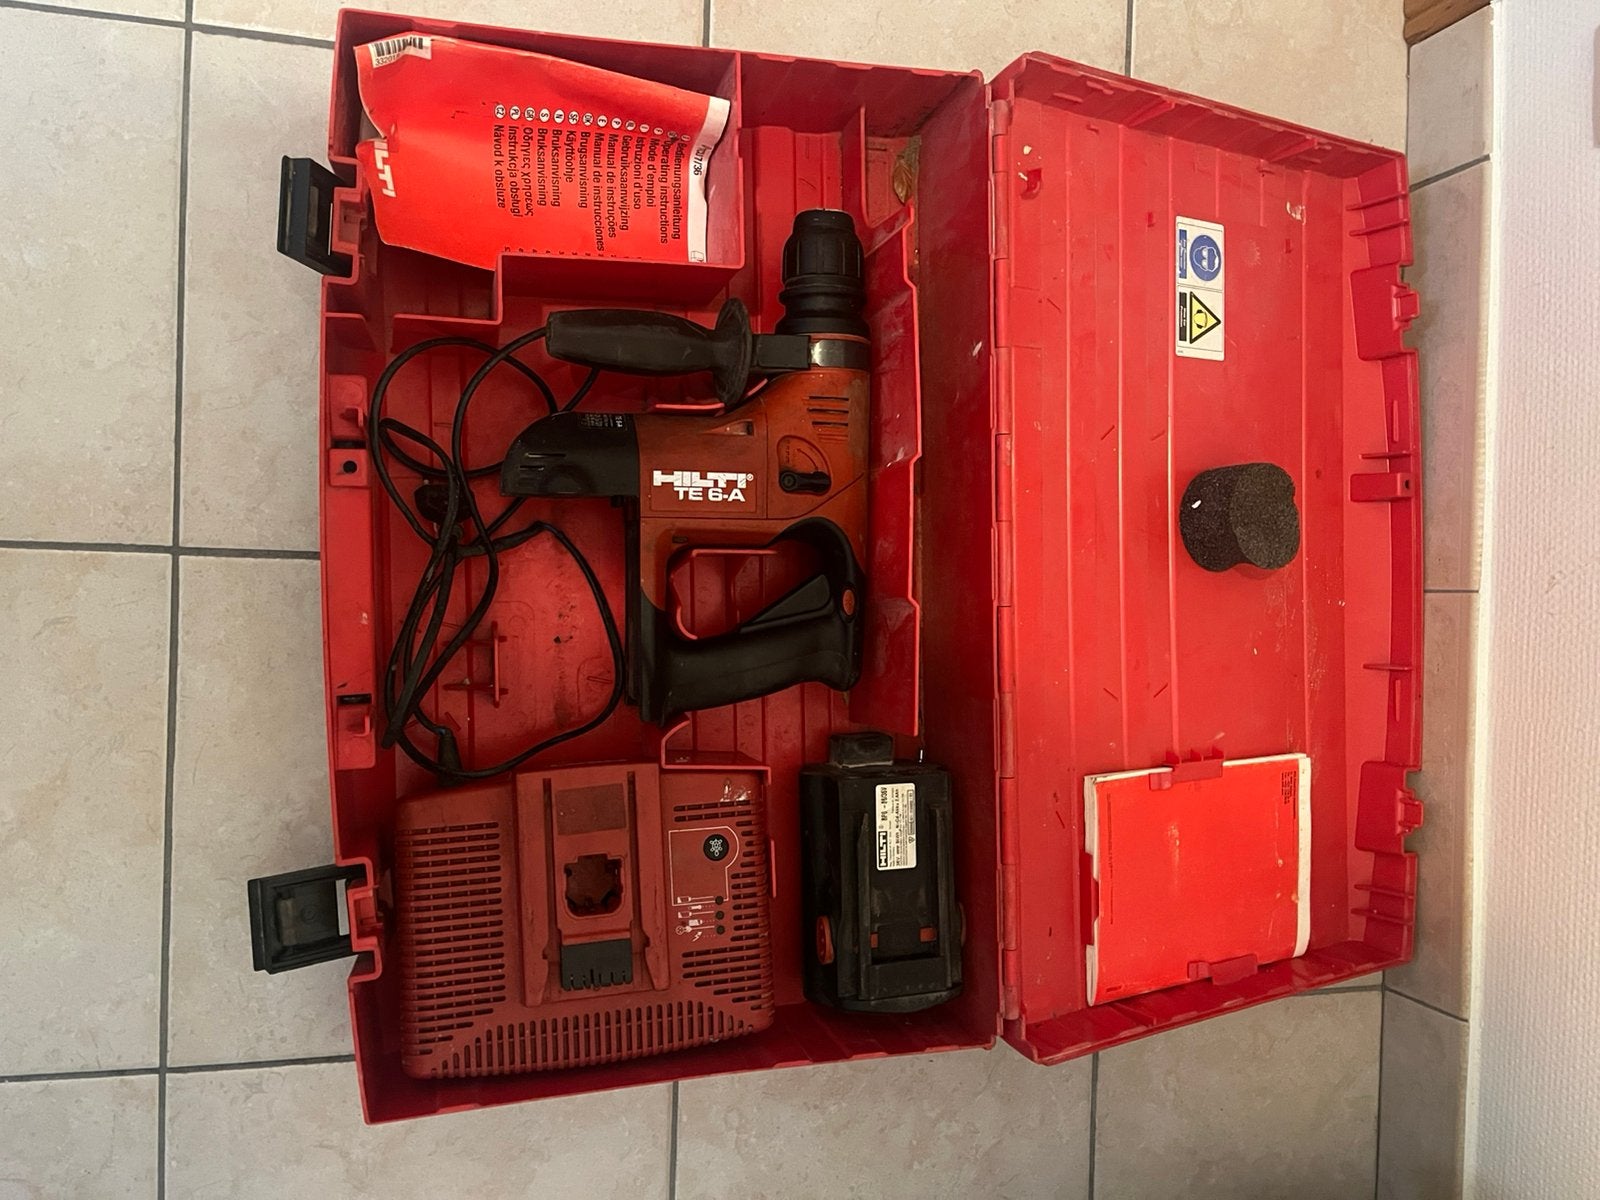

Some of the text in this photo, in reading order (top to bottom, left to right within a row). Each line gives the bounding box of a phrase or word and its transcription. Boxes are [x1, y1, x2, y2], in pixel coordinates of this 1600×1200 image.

[493, 125, 506, 157] Návod
[508, 126, 519, 178] Instrukcja
[564, 130, 577, 183] Käyttöohje
[593, 132, 605, 168] Manual
[607, 134, 619, 169] Manual
[633, 137, 646, 179] Istruzioni
[647, 138, 659, 162] Mode
[374, 139, 397, 198] ILTI
[536, 128, 548, 206] Bruksanvisning
[550, 129, 562, 206] Bruksanvisning
[577, 131, 590, 208] Brugsanvisning
[593, 171, 604, 183] de
[607, 172, 618, 183] de
[618, 135, 632, 231] Gebruiksaanwijzing
[645, 164, 657, 207] d'emploi
[605, 186, 618, 238] instruções
[633, 183, 643, 209] d'uso
[659, 139, 673, 243] Operating instructions
[672, 143, 686, 239] Bedienungsanleitung
[593, 185, 605, 251] instrucciones
[673, 487, 746, 502] TE 6-A
[879, 832, 887, 867] HILTI
